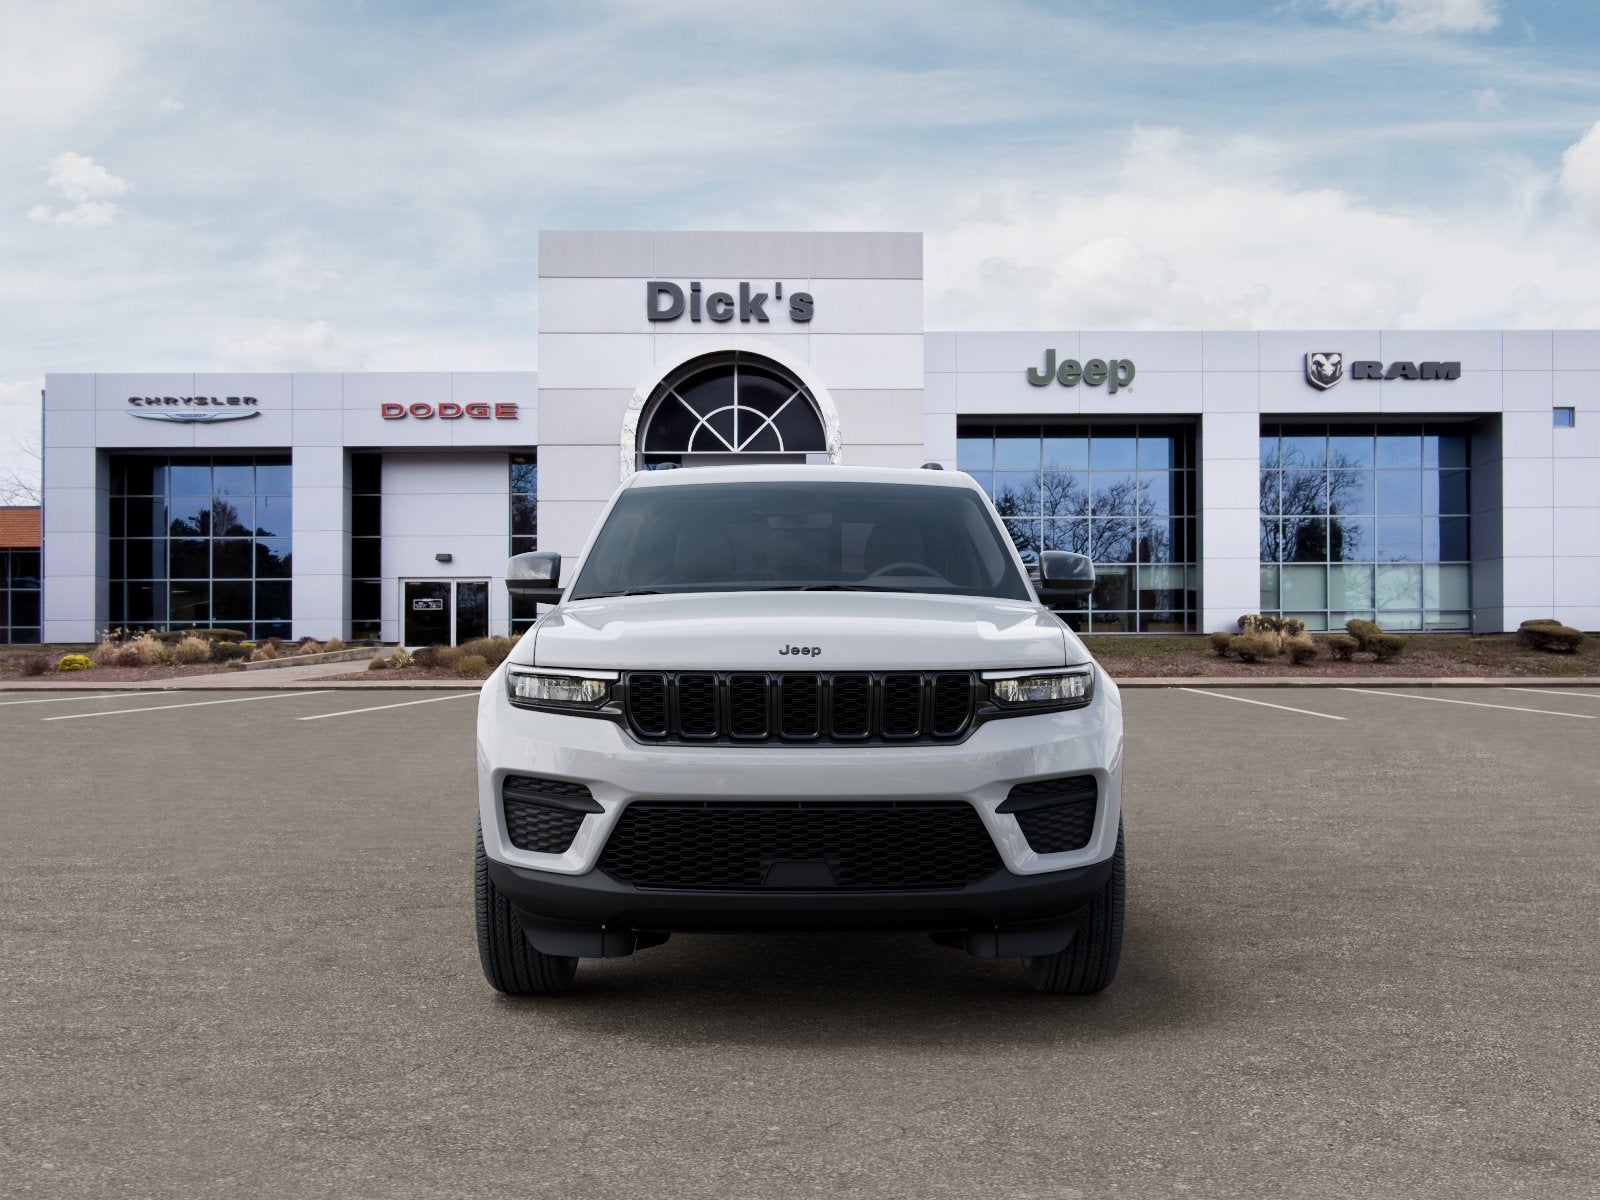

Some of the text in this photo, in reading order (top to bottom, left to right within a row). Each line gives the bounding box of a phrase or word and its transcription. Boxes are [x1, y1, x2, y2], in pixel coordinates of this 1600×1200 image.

[647, 281, 814, 323] Dick's
[1027, 348, 1136, 394] Jeep
[1352, 360, 1462, 380] RAM
[127, 396, 259, 407] CHRYSLER
[381, 402, 519, 420] DODGE
[778, 644, 822, 658] Jeep
